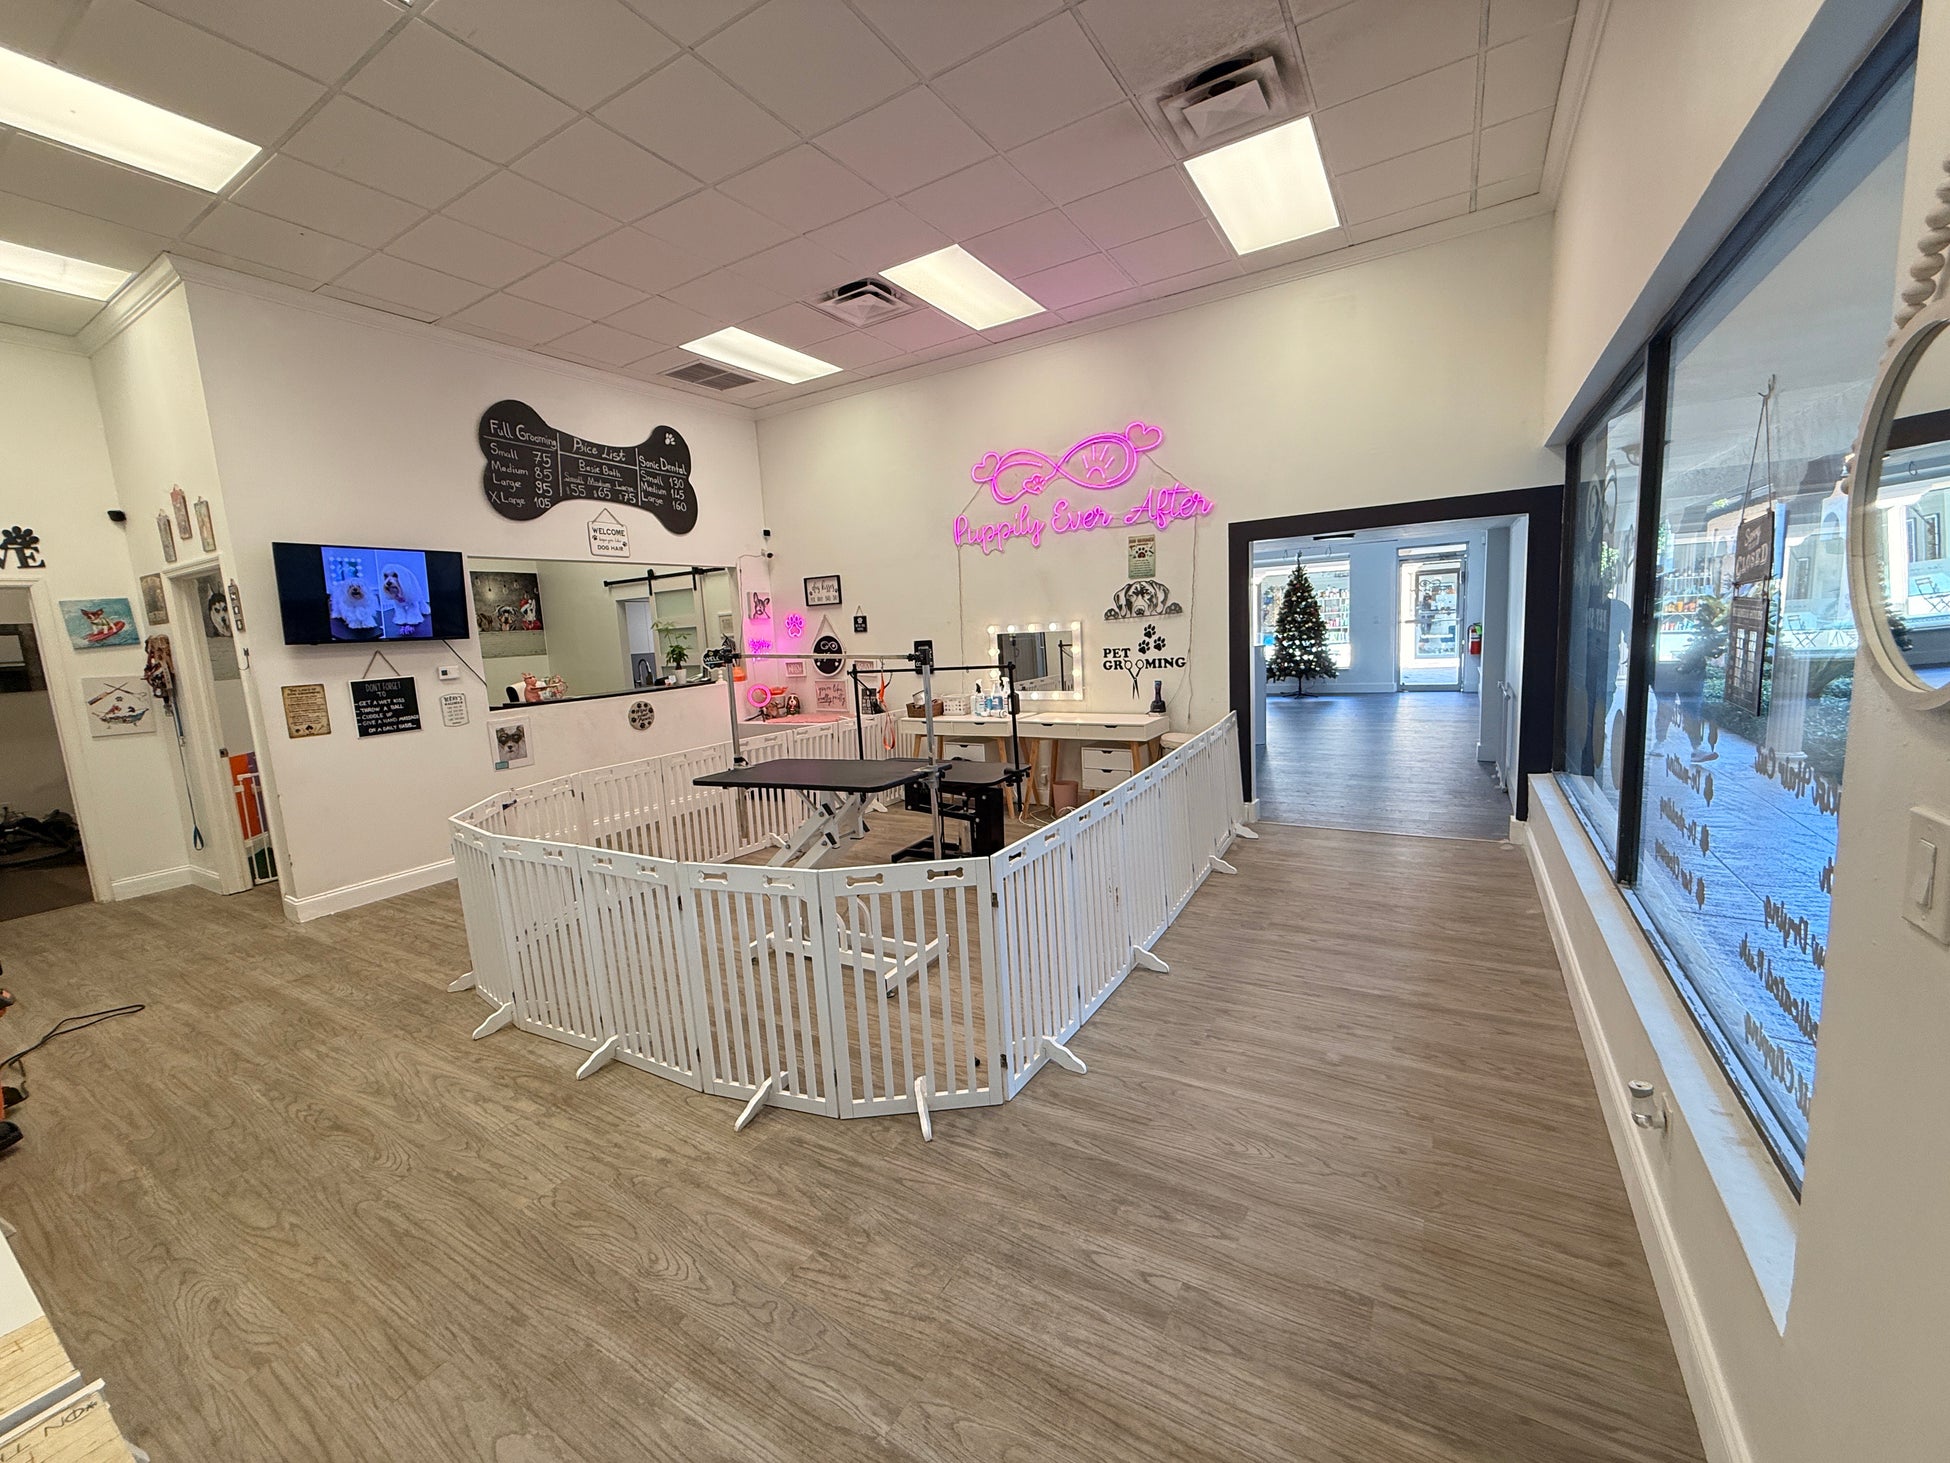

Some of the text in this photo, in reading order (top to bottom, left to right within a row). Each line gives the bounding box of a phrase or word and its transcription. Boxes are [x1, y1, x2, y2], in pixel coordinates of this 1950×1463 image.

[490, 420, 557, 450] Full Grooming
[490, 442, 551, 468] Small 75
[572, 438, 626, 462] Price List
[491, 460, 552, 482] Medium 85
[578, 460, 621, 477] Basic Bath
[638, 456, 688, 475] Sonic Dental
[492, 473, 552, 496] Large 95
[564, 472, 585, 484] Small
[640, 470, 684, 488] Small 130
[640, 480, 685, 500] Medium 145
[534, 496, 552, 508] 105
[642, 492, 687, 512] Large 160
[953, 482, 1215, 555] Puppily Ever After
[592, 526, 626, 536] WELCOME
[1736, 542, 1769, 578] CLOSED
[1102, 648, 1131, 659] PET
